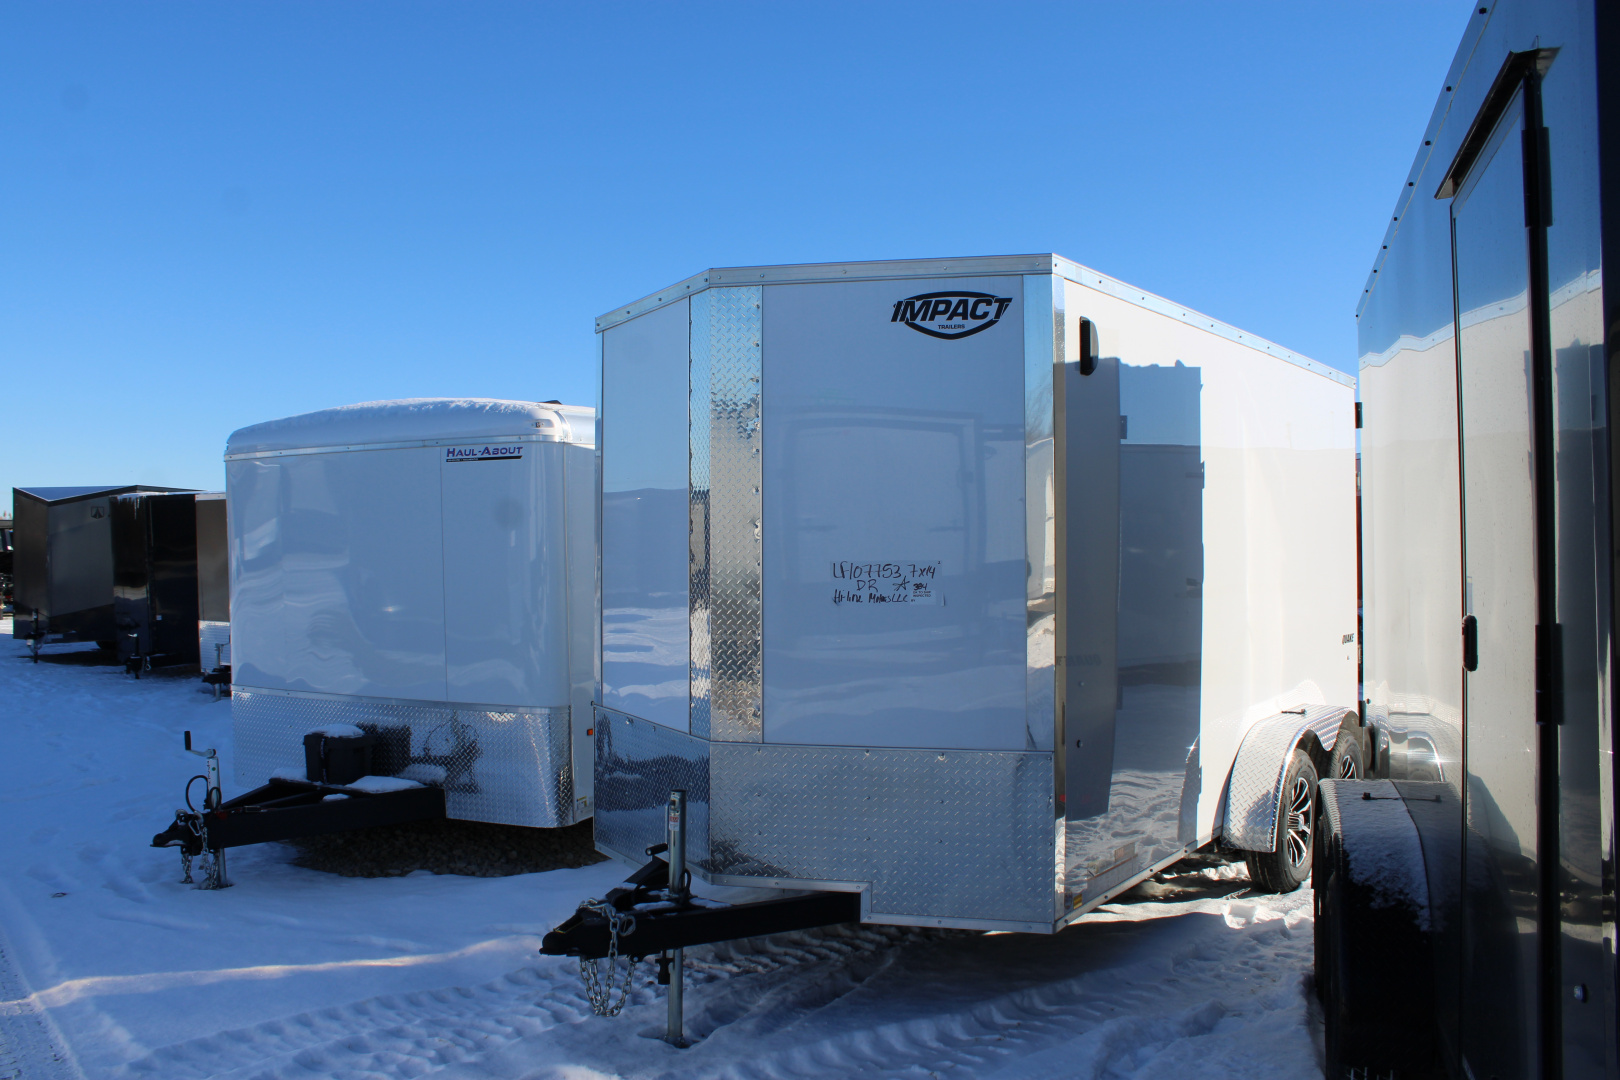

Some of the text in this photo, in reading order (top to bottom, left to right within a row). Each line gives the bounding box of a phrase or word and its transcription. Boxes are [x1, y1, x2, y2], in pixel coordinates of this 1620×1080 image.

[891, 297, 1013, 322] IMPACT
[446, 446, 523, 458] HAUL-ABOUT
[857, 579, 879, 593] DR
